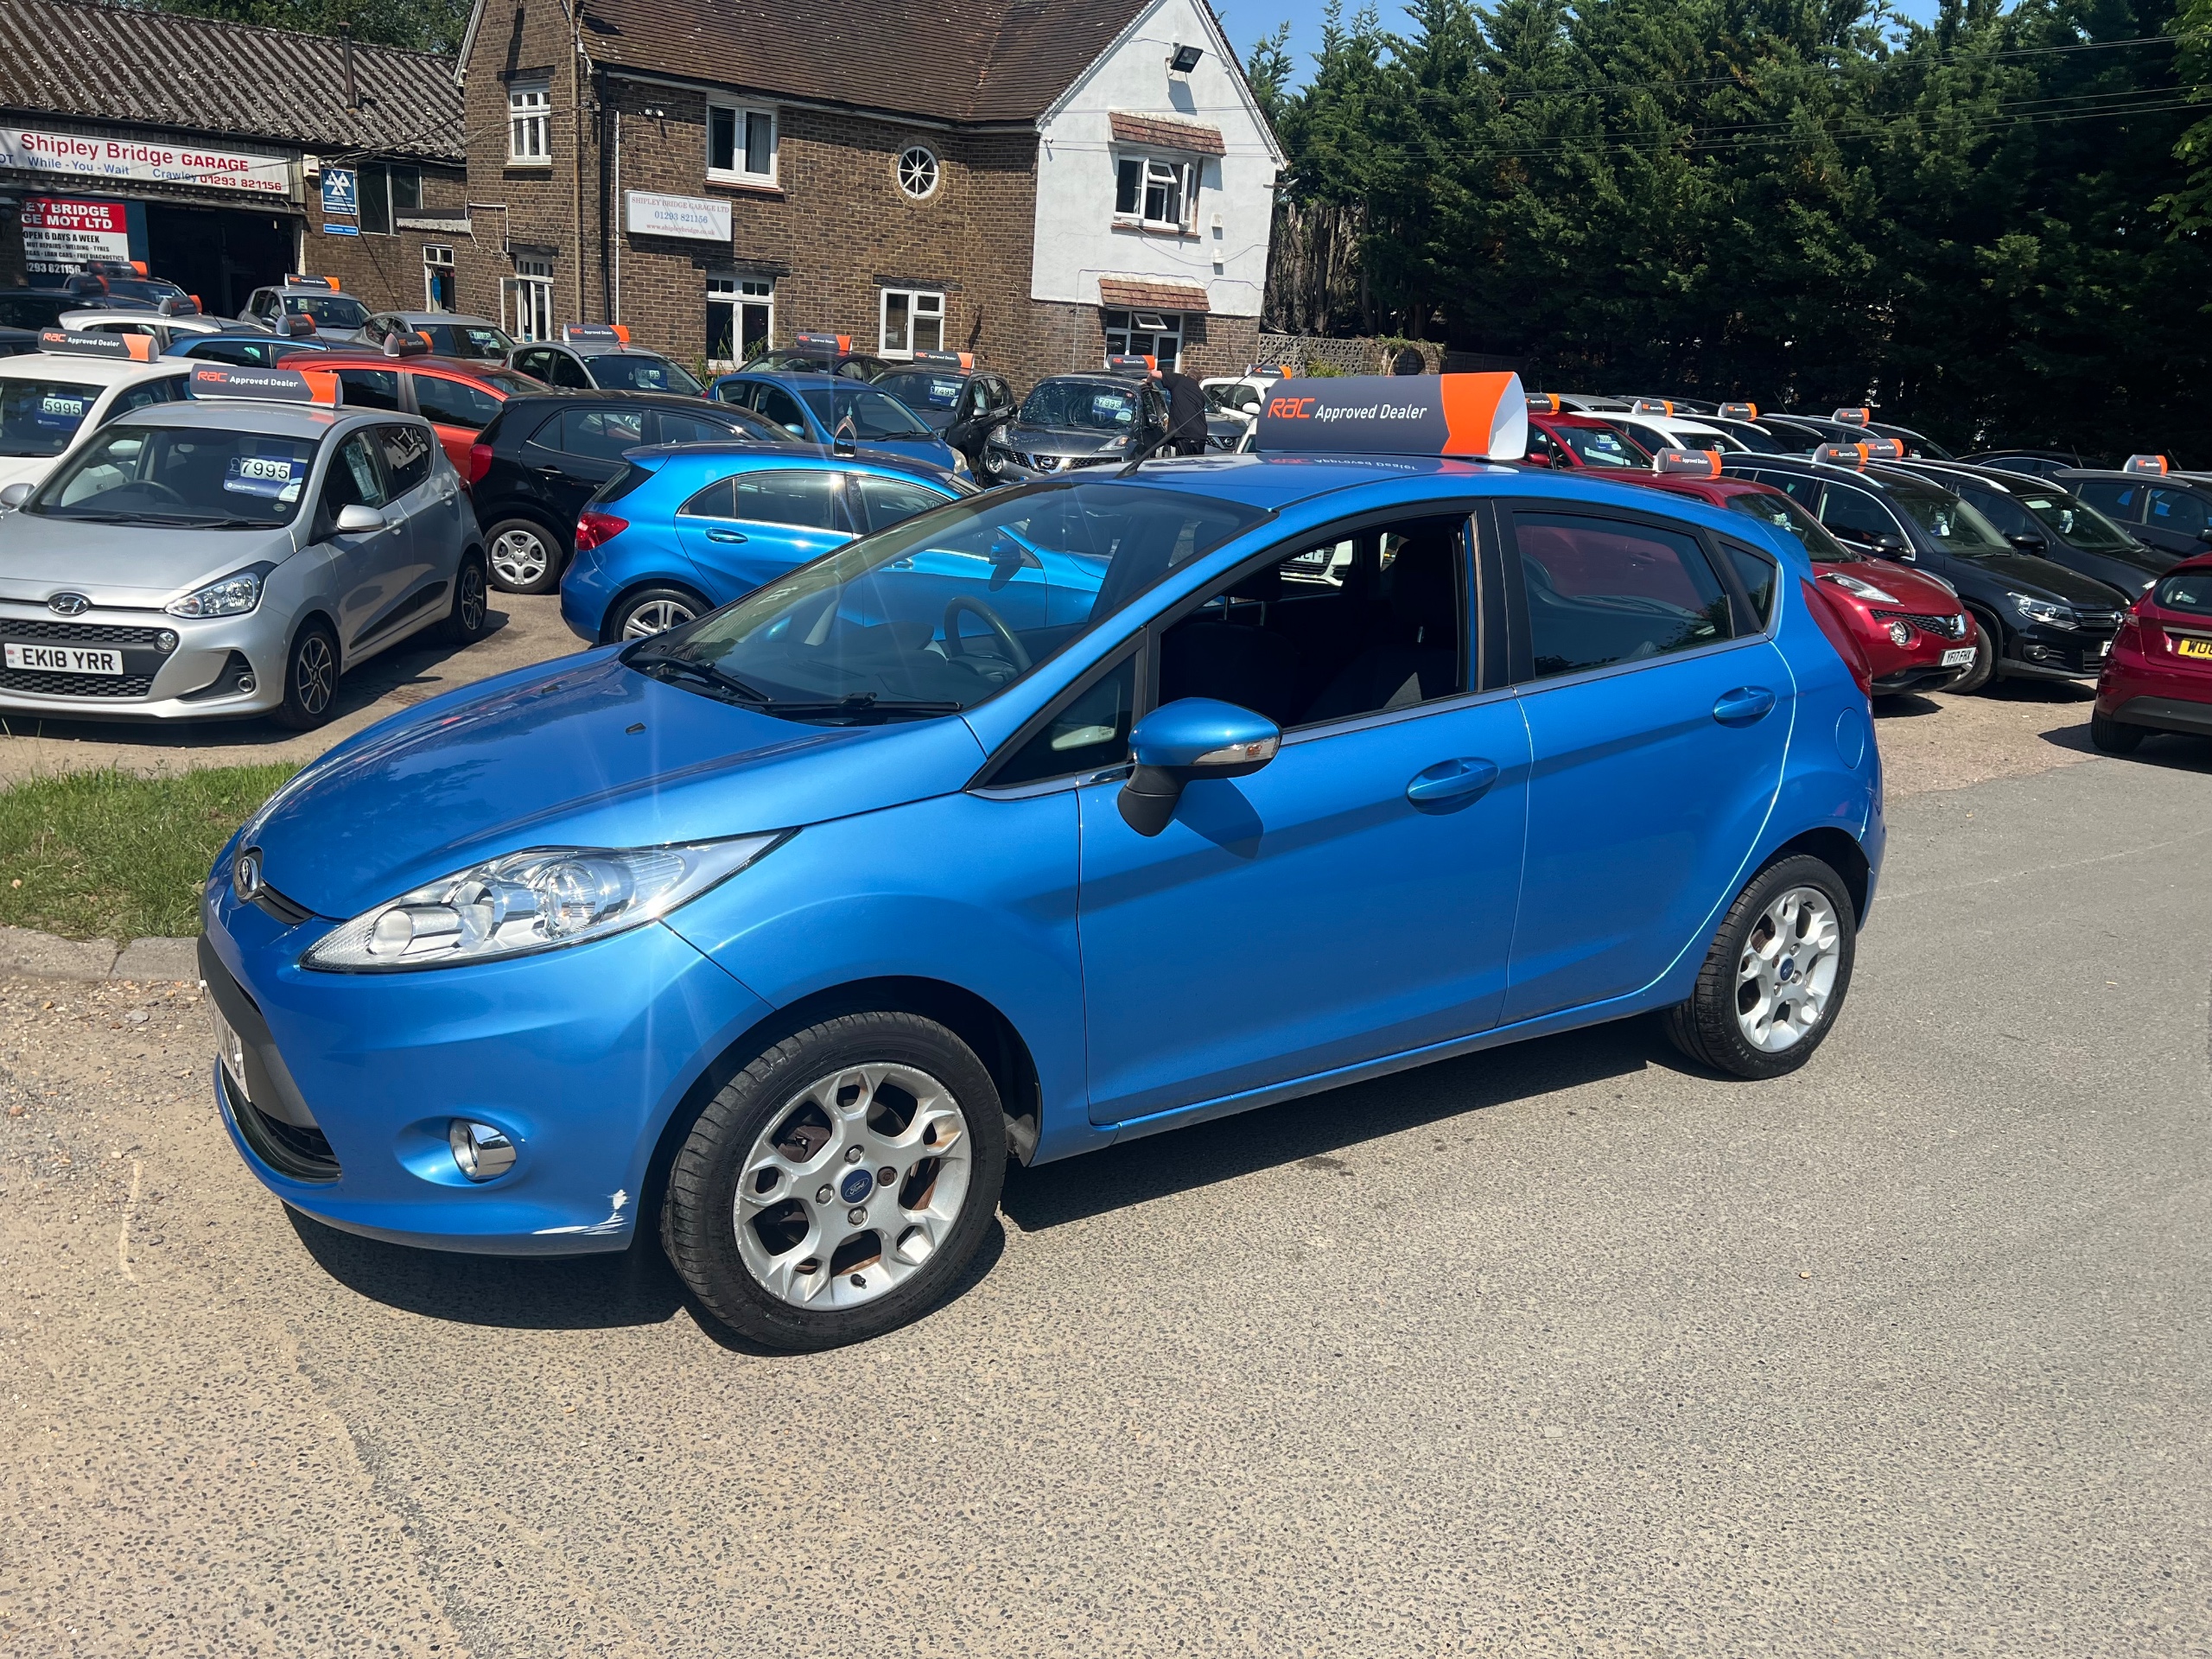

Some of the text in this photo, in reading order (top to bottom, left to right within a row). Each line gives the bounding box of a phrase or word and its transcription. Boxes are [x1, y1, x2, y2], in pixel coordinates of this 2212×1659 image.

[21, 133, 249, 172] Shipley Bridge GARAGE
[28, 156, 61, 168] While
[72, 160, 93, 172] You
[104, 163, 130, 175] Wait
[152, 168, 282, 191] Crawley 01293 821156
[51, 203, 110, 218] BRIDGE
[632, 196, 729, 213] SHIPLEY BRIDGE GARAGE LTD
[47, 214, 80, 227] MOT
[85, 217, 113, 230] LTD
[654, 210, 708, 224] 01293 821156
[23, 231, 100, 244] OPEN 6 DAYS A WEEK
[646, 223, 715, 236] www.shipleybridge.co.uk
[67, 336, 97, 346] Approved
[98, 339, 120, 347] Dealer
[197, 371, 298, 388] RAC Approved Dealer
[1267, 397, 1427, 423] RAC Approved Dealer
[22, 647, 115, 671] EK18 YRR
